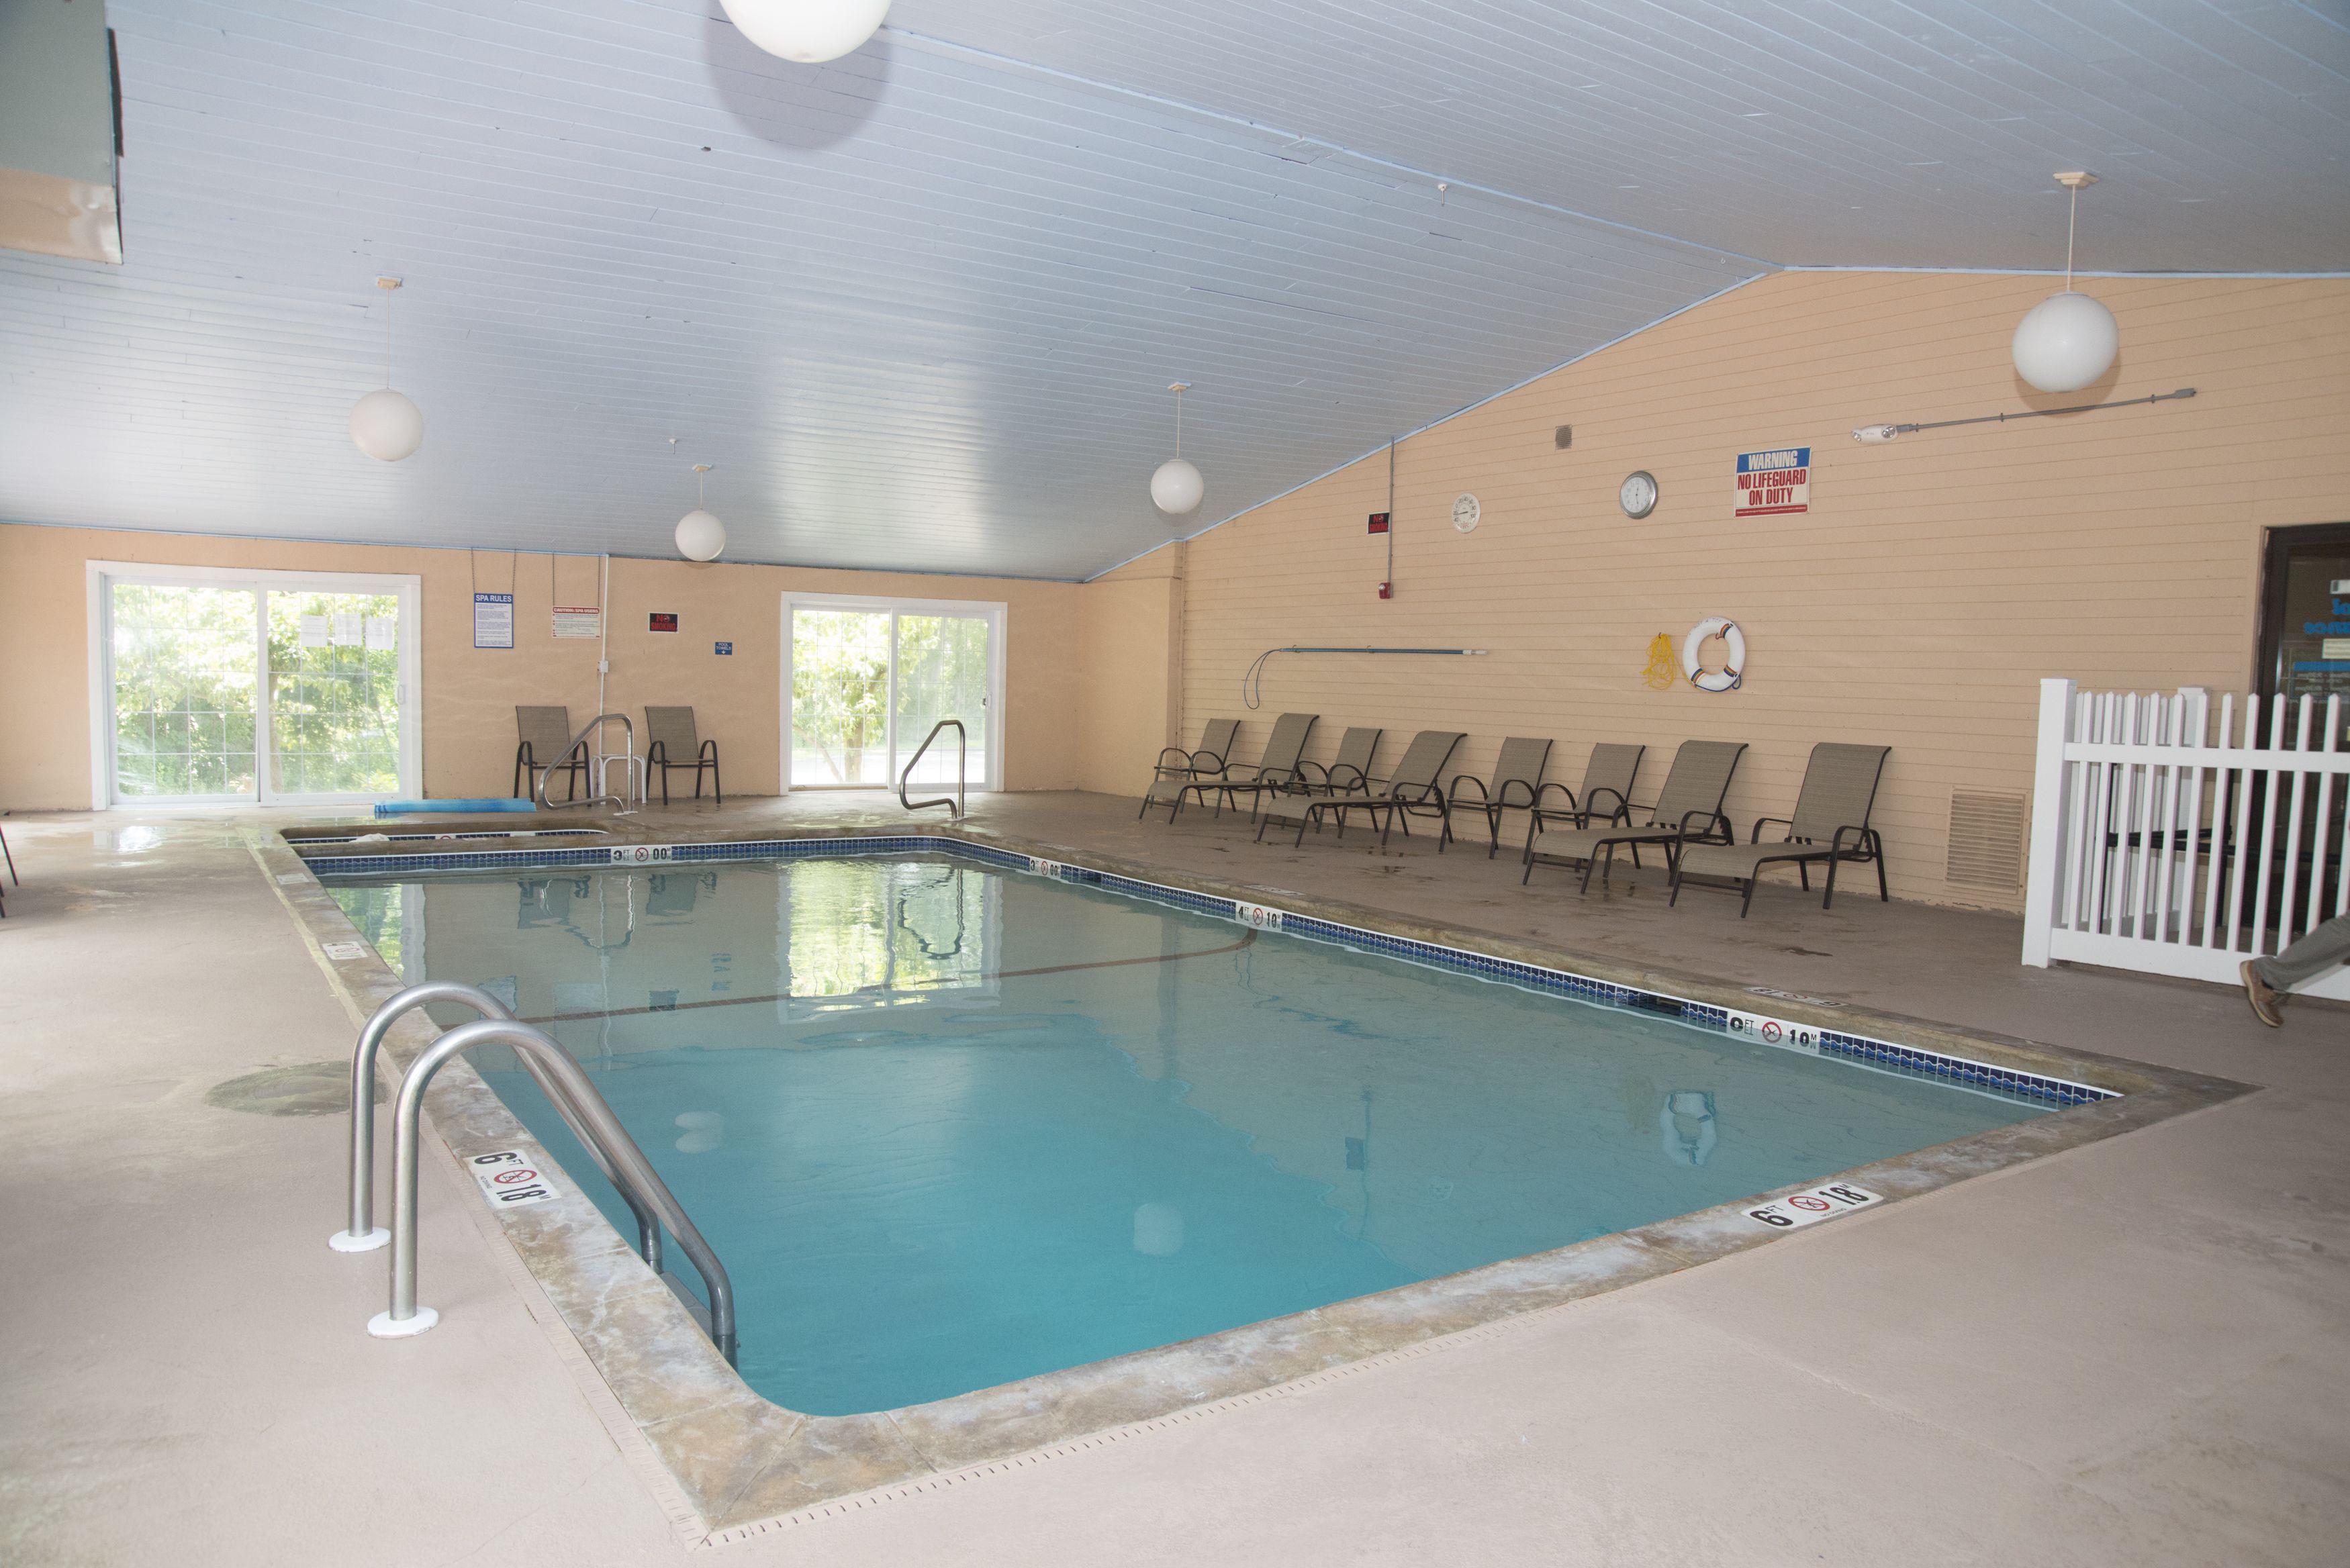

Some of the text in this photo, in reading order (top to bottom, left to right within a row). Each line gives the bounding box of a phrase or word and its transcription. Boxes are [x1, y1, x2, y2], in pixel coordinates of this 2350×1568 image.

[1748, 450, 1798, 471] WARNING
[1738, 469, 1807, 490] NO LIFEGUARD
[1749, 487, 1793, 505] ON DUTY
[656, 614, 670, 622] NO
[474, 1152, 517, 1165] 6
[1765, 1205, 1784, 1214] FT
[1749, 1210, 1793, 1226] 6
